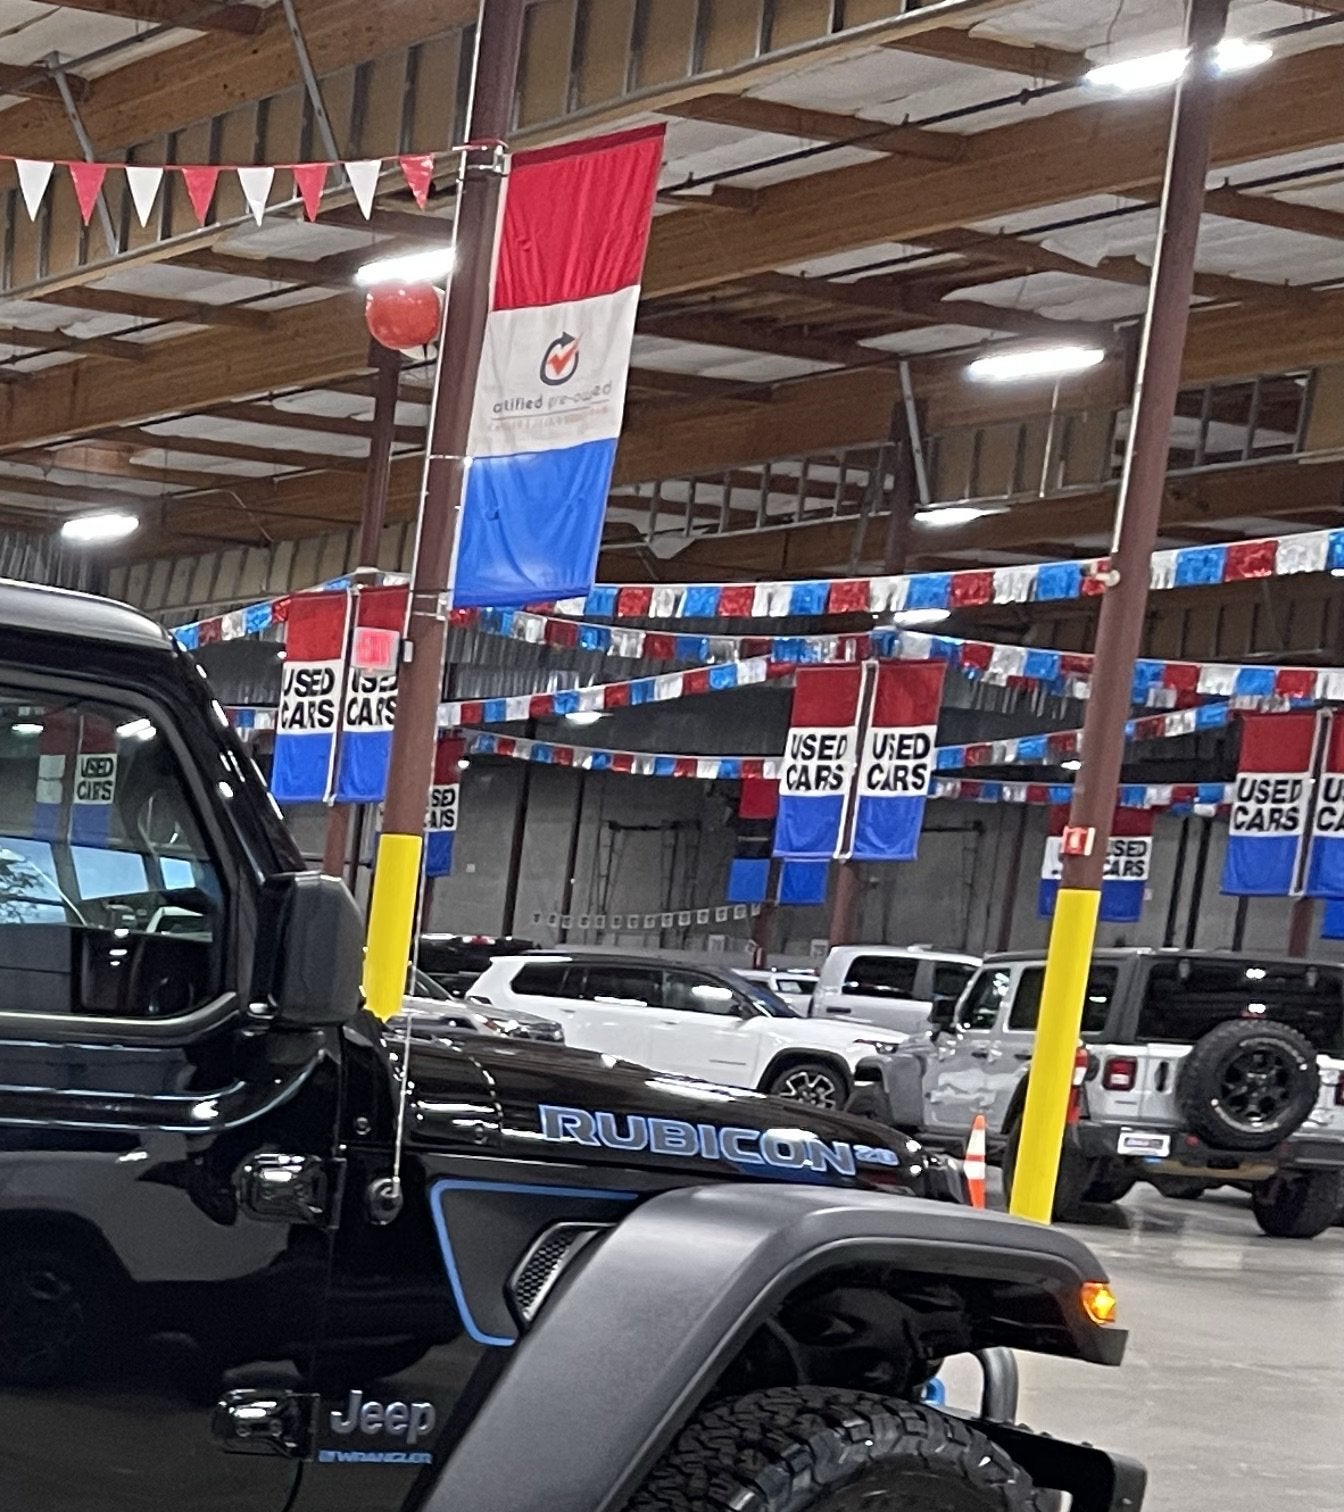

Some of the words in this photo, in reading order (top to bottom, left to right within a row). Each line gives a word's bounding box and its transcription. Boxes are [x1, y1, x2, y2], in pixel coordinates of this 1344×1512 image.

[283, 668, 335, 697] USED
[282, 699, 335, 728] CARS
[347, 696, 396, 726] CARS
[791, 733, 848, 760] USED
[872, 733, 931, 760] USED
[81, 757, 114, 778] USED
[786, 764, 845, 791] CARS
[867, 763, 928, 791] CARS
[431, 788, 456, 807] SED
[1237, 777, 1303, 804] USED
[1234, 806, 1300, 832] CARS
[1108, 840, 1147, 857] SED
[1104, 860, 1145, 877] ARS
[538, 1104, 857, 1176] RUBICON
[330, 1389, 436, 1444] Jeep
